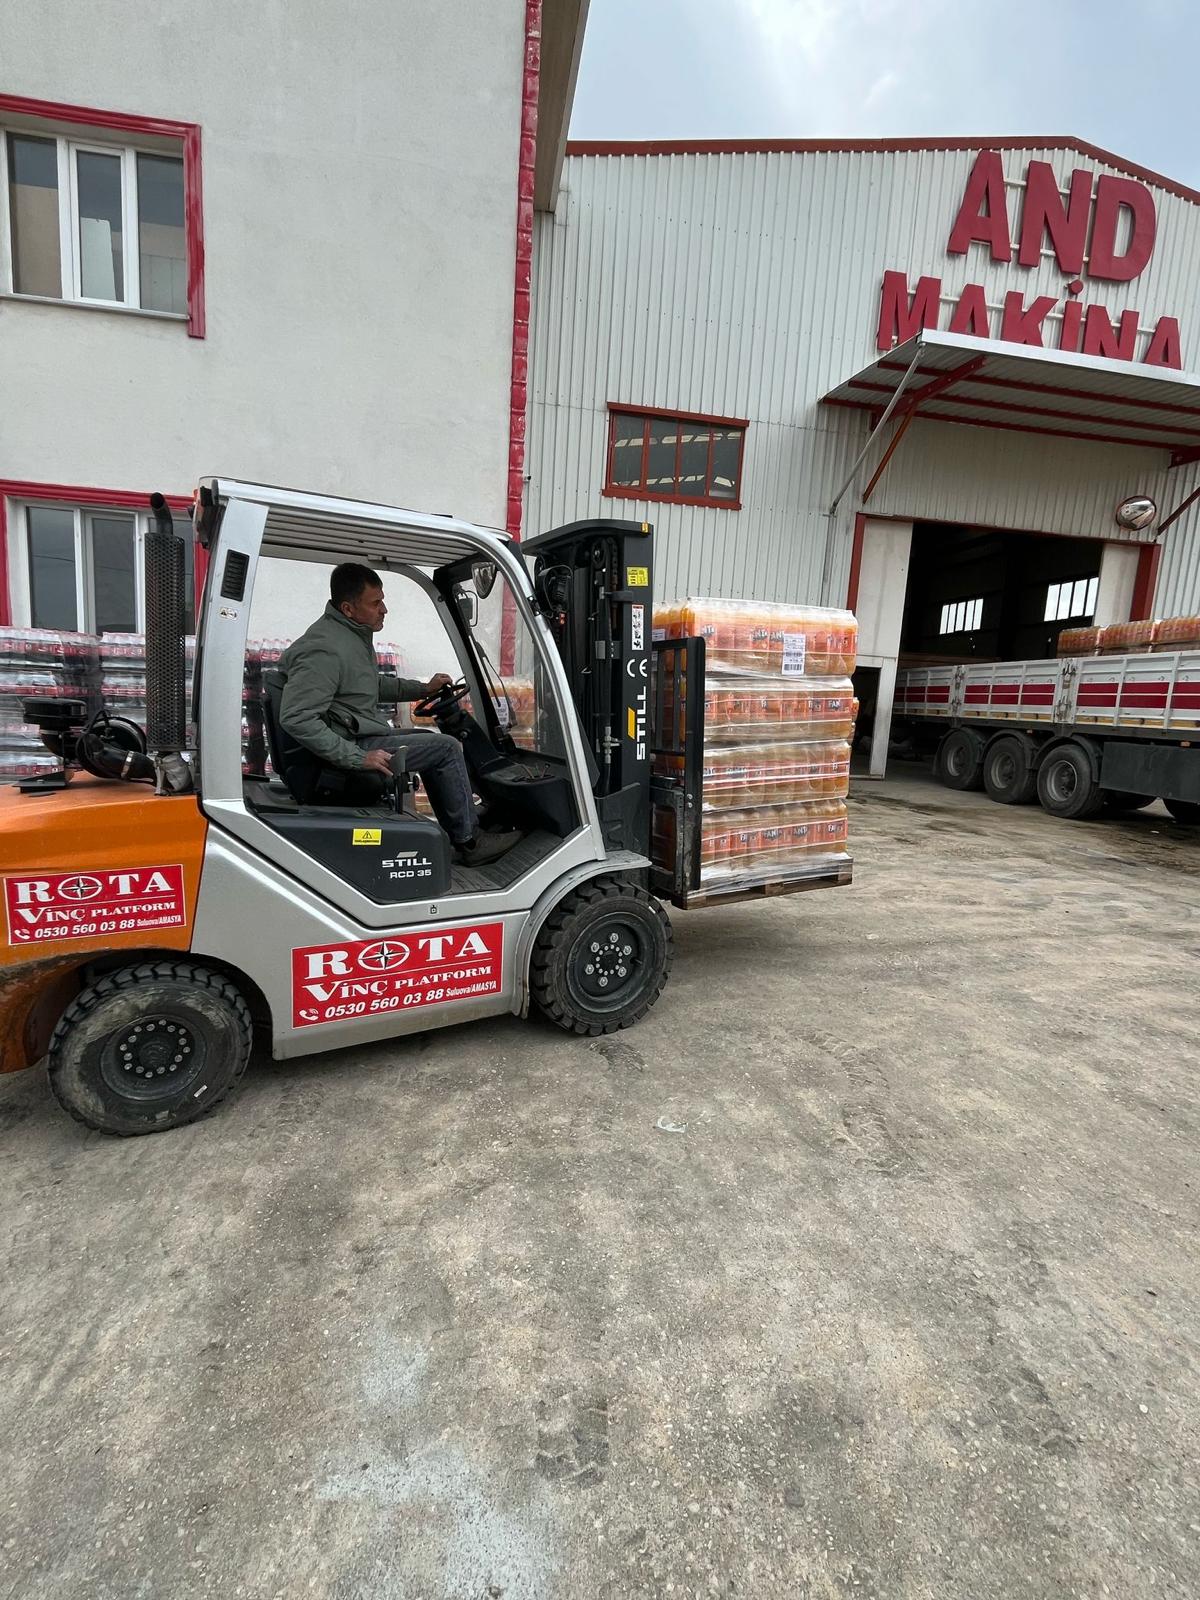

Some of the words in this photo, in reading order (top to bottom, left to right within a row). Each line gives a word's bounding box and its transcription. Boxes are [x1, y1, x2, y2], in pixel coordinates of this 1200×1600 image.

[947, 149, 1156, 281] AND
[877, 270, 1182, 370] MAKİNA
[636, 686, 647, 761] STILL
[382, 858, 432, 868] STILL
[390, 870, 415, 879] RCD
[417, 869, 432, 877] 35
[14, 871, 174, 904] ROTA
[91, 902, 175, 918] PLATFORM
[35, 925, 68, 939] 0530
[72, 923, 96, 935] 560
[100, 920, 115, 932] 03
[119, 918, 135, 930] 88
[304, 932, 492, 980] ROTA
[394, 966, 492, 990] PLATFORM
[325, 1001, 366, 1019] 0530
[370, 996, 399, 1011] 560
[403, 992, 422, 1005] 03
[426, 988, 444, 1001] 88
